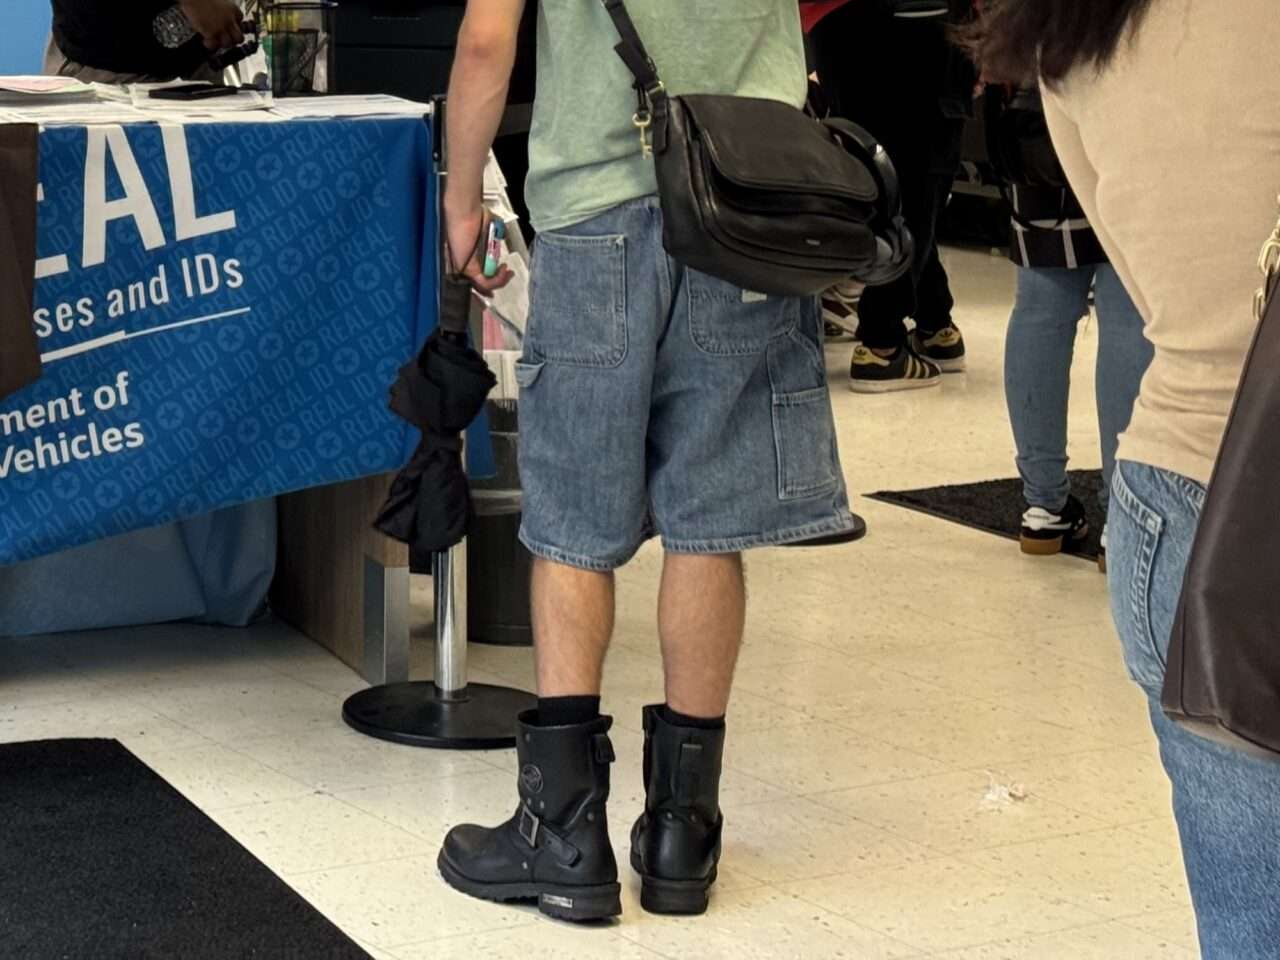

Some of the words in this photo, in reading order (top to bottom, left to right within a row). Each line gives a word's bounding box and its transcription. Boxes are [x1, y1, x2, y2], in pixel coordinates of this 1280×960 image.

[107, 264, 169, 319] and
[181, 253, 244, 299] IDs
[94, 372, 130, 411] of
